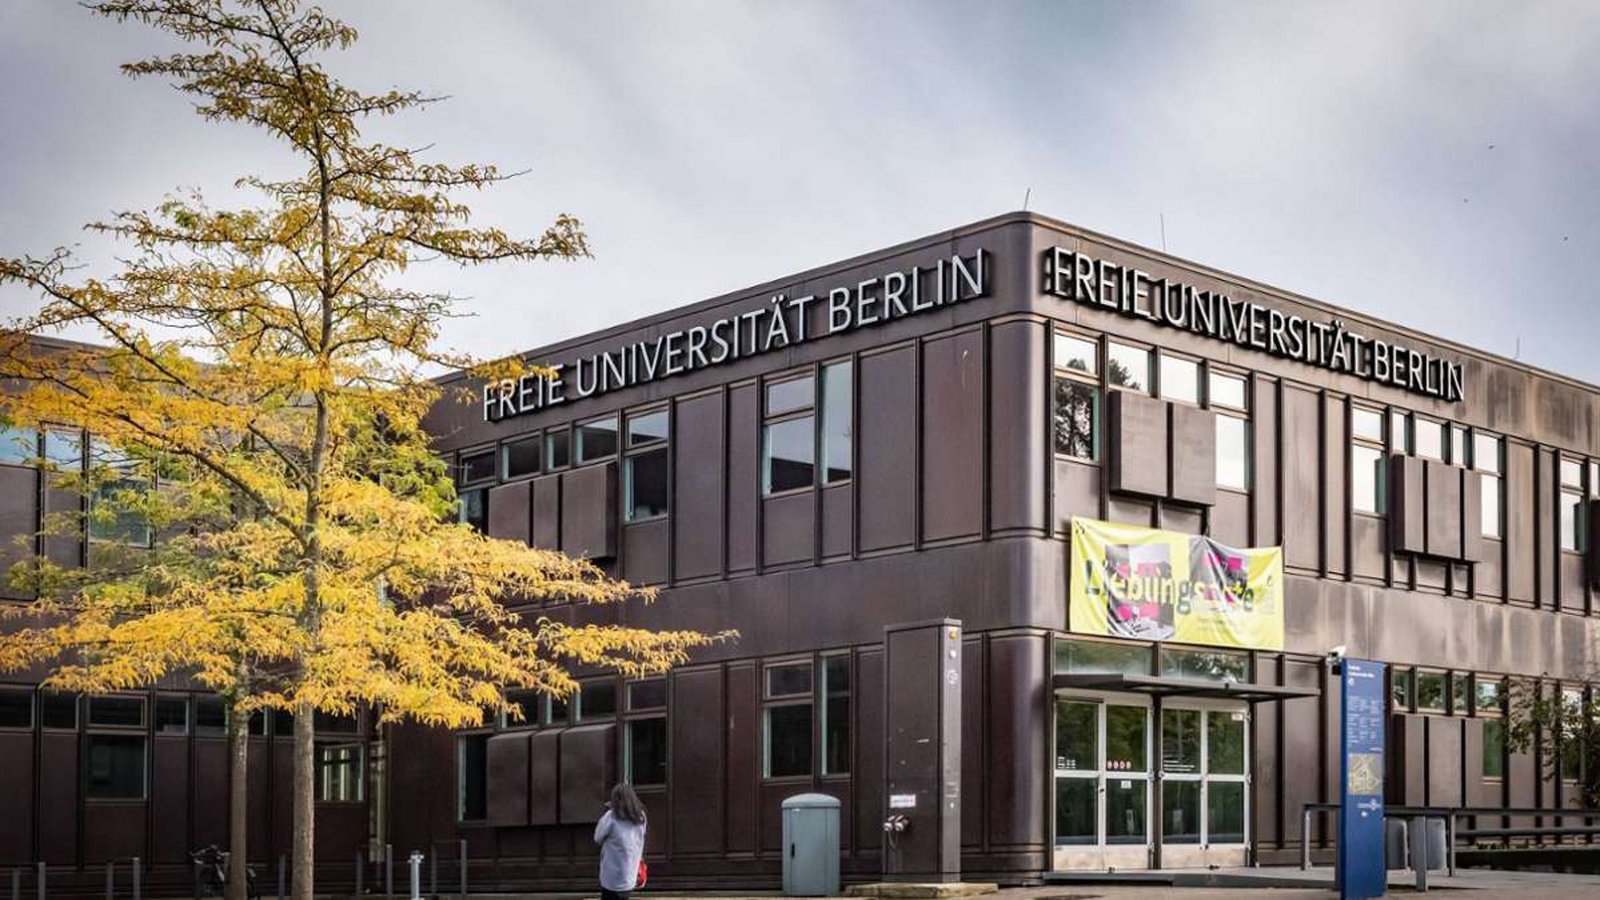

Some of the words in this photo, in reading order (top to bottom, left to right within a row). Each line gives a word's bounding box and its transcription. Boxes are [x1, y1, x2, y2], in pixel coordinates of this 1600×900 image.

[483, 363, 565, 421] FREIE
[577, 295, 815, 398] UNIVERSITÄT
[828, 248, 985, 335] BERLIN
[1053, 246, 1151, 318] FREIE
[1164, 282, 1365, 377] UNIVERSITÄT
[1373, 340, 1466, 401] BERLIN
